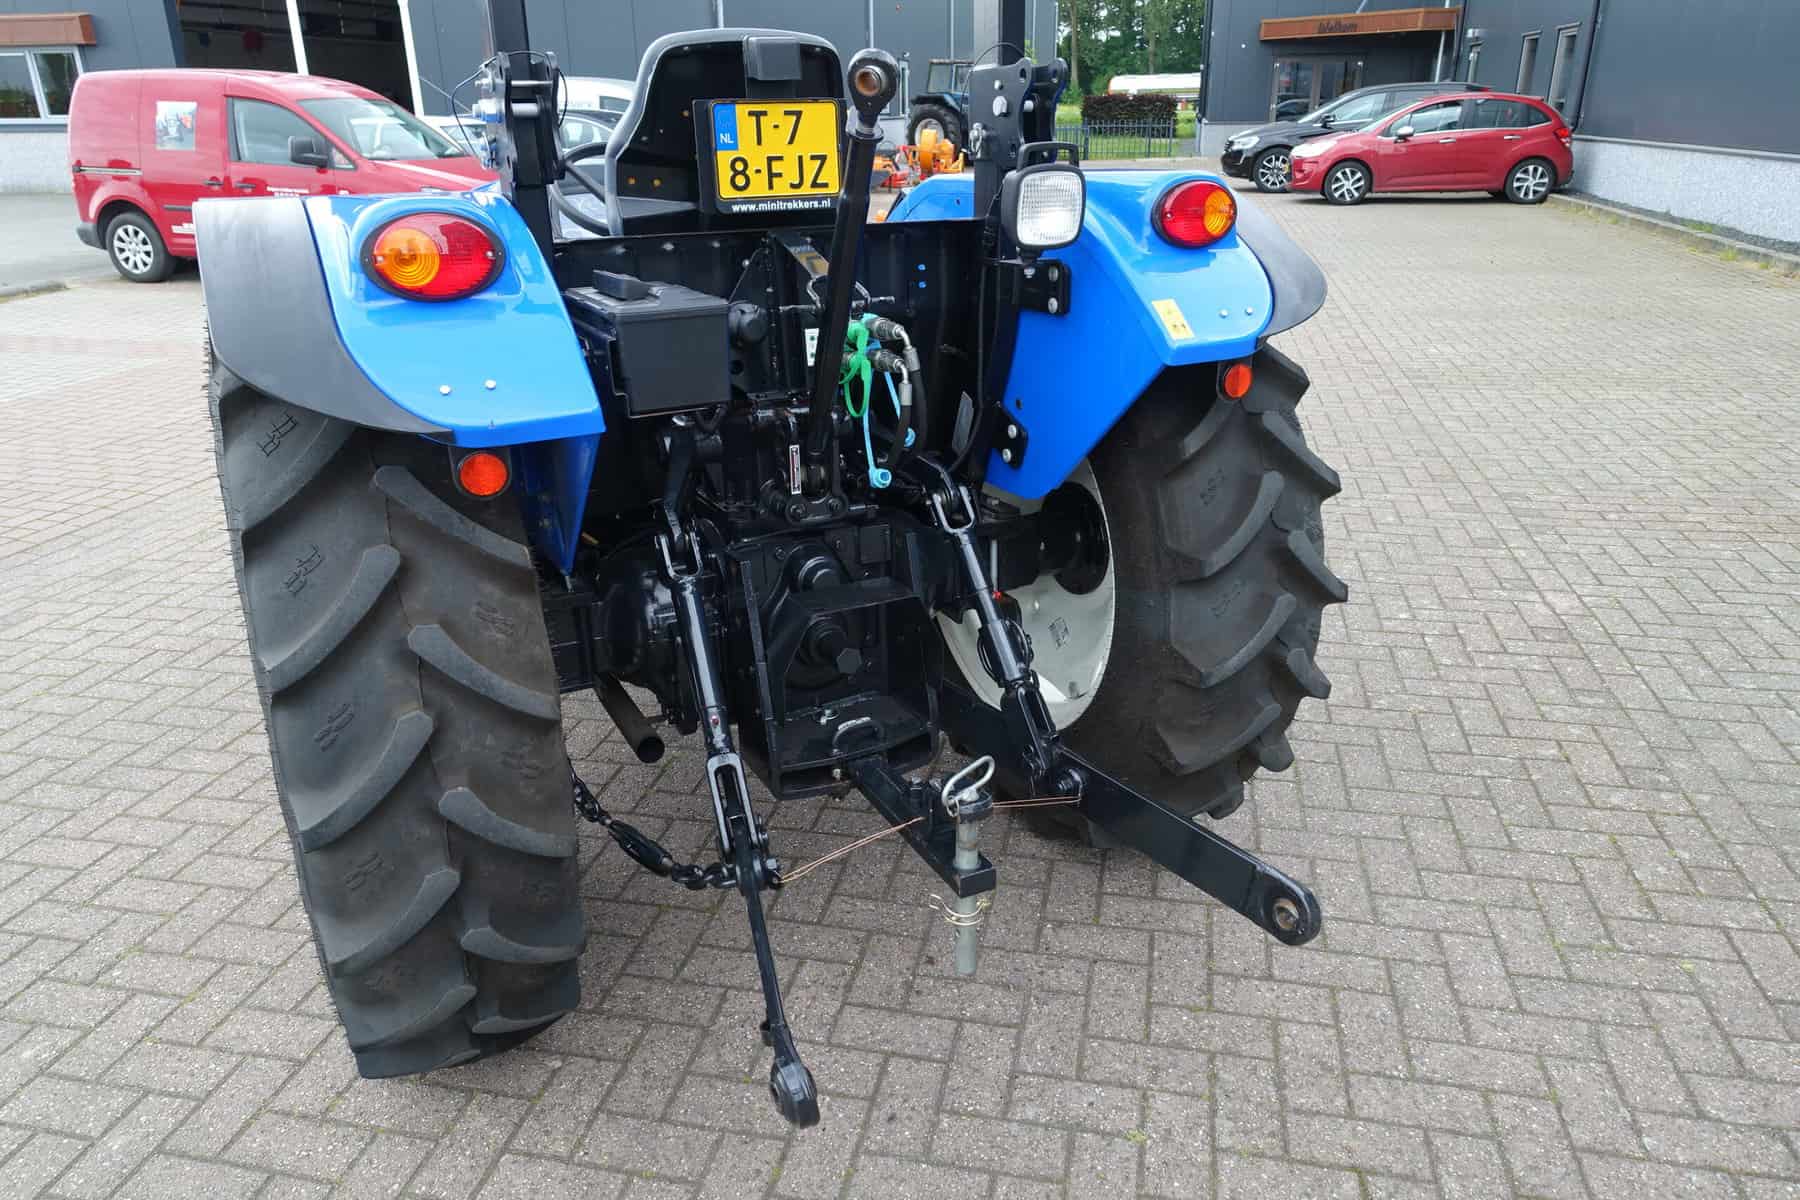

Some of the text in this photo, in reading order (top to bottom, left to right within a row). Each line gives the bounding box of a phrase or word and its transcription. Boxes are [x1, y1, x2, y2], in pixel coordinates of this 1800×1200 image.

[719, 133, 734, 143] NL
[748, 111, 802, 145] T-7
[729, 155, 829, 191] 8-FJZ
[731, 199, 831, 213] www.minitrekkers.nl
